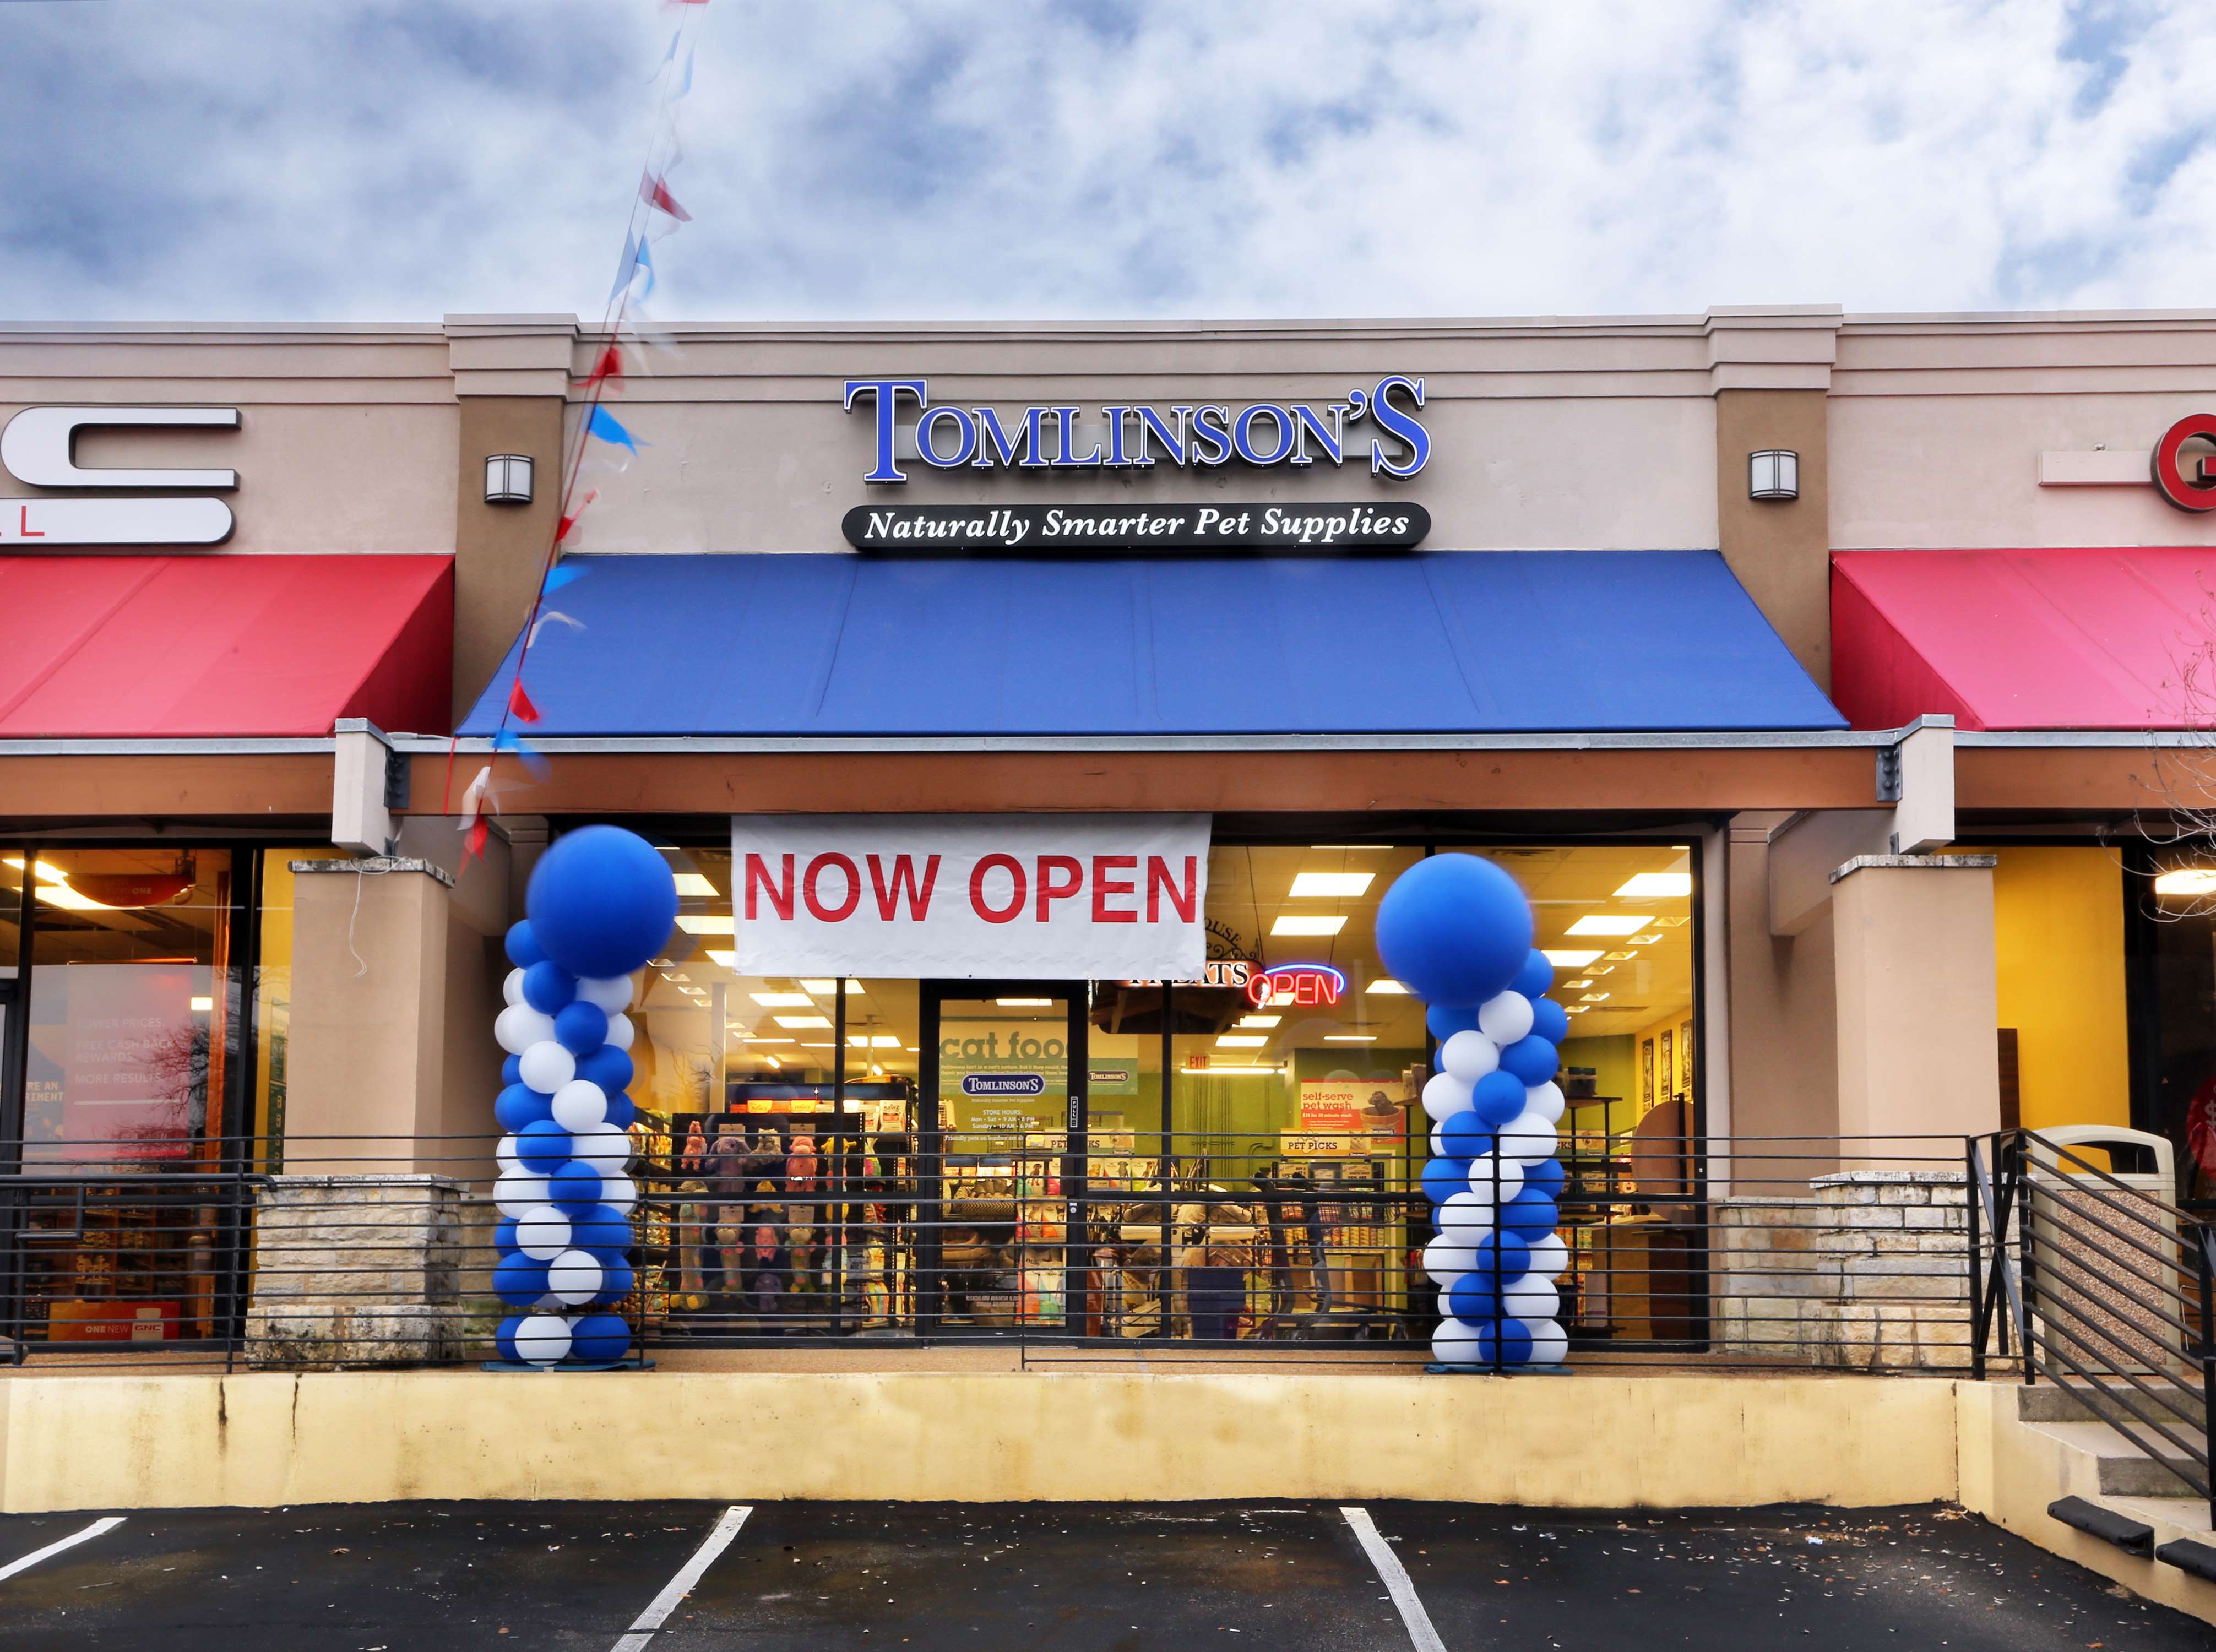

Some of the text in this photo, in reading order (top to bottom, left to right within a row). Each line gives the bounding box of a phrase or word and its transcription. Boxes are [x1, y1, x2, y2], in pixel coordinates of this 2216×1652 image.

[843, 375, 1432, 482] TOMLINSON'S
[864, 508, 1409, 545] Naturally Smarter Pet Supplies
[745, 852, 1197, 924] NOW OPEN
[1247, 972, 1338, 1005] OPEN
[108, 1039, 139, 1049] CASH
[143, 1039, 175, 1048] BACK
[939, 1031, 1068, 1059] cat foo
[1190, 1056, 1207, 1069] EXIT
[44, 1081, 58, 1091] AN
[75, 1074, 110, 1084] MORE
[968, 1077, 1038, 1092] TOMLINSON'S
[1303, 1092, 1353, 1100] self-serve
[1303, 1101, 1352, 1110] pet wash
